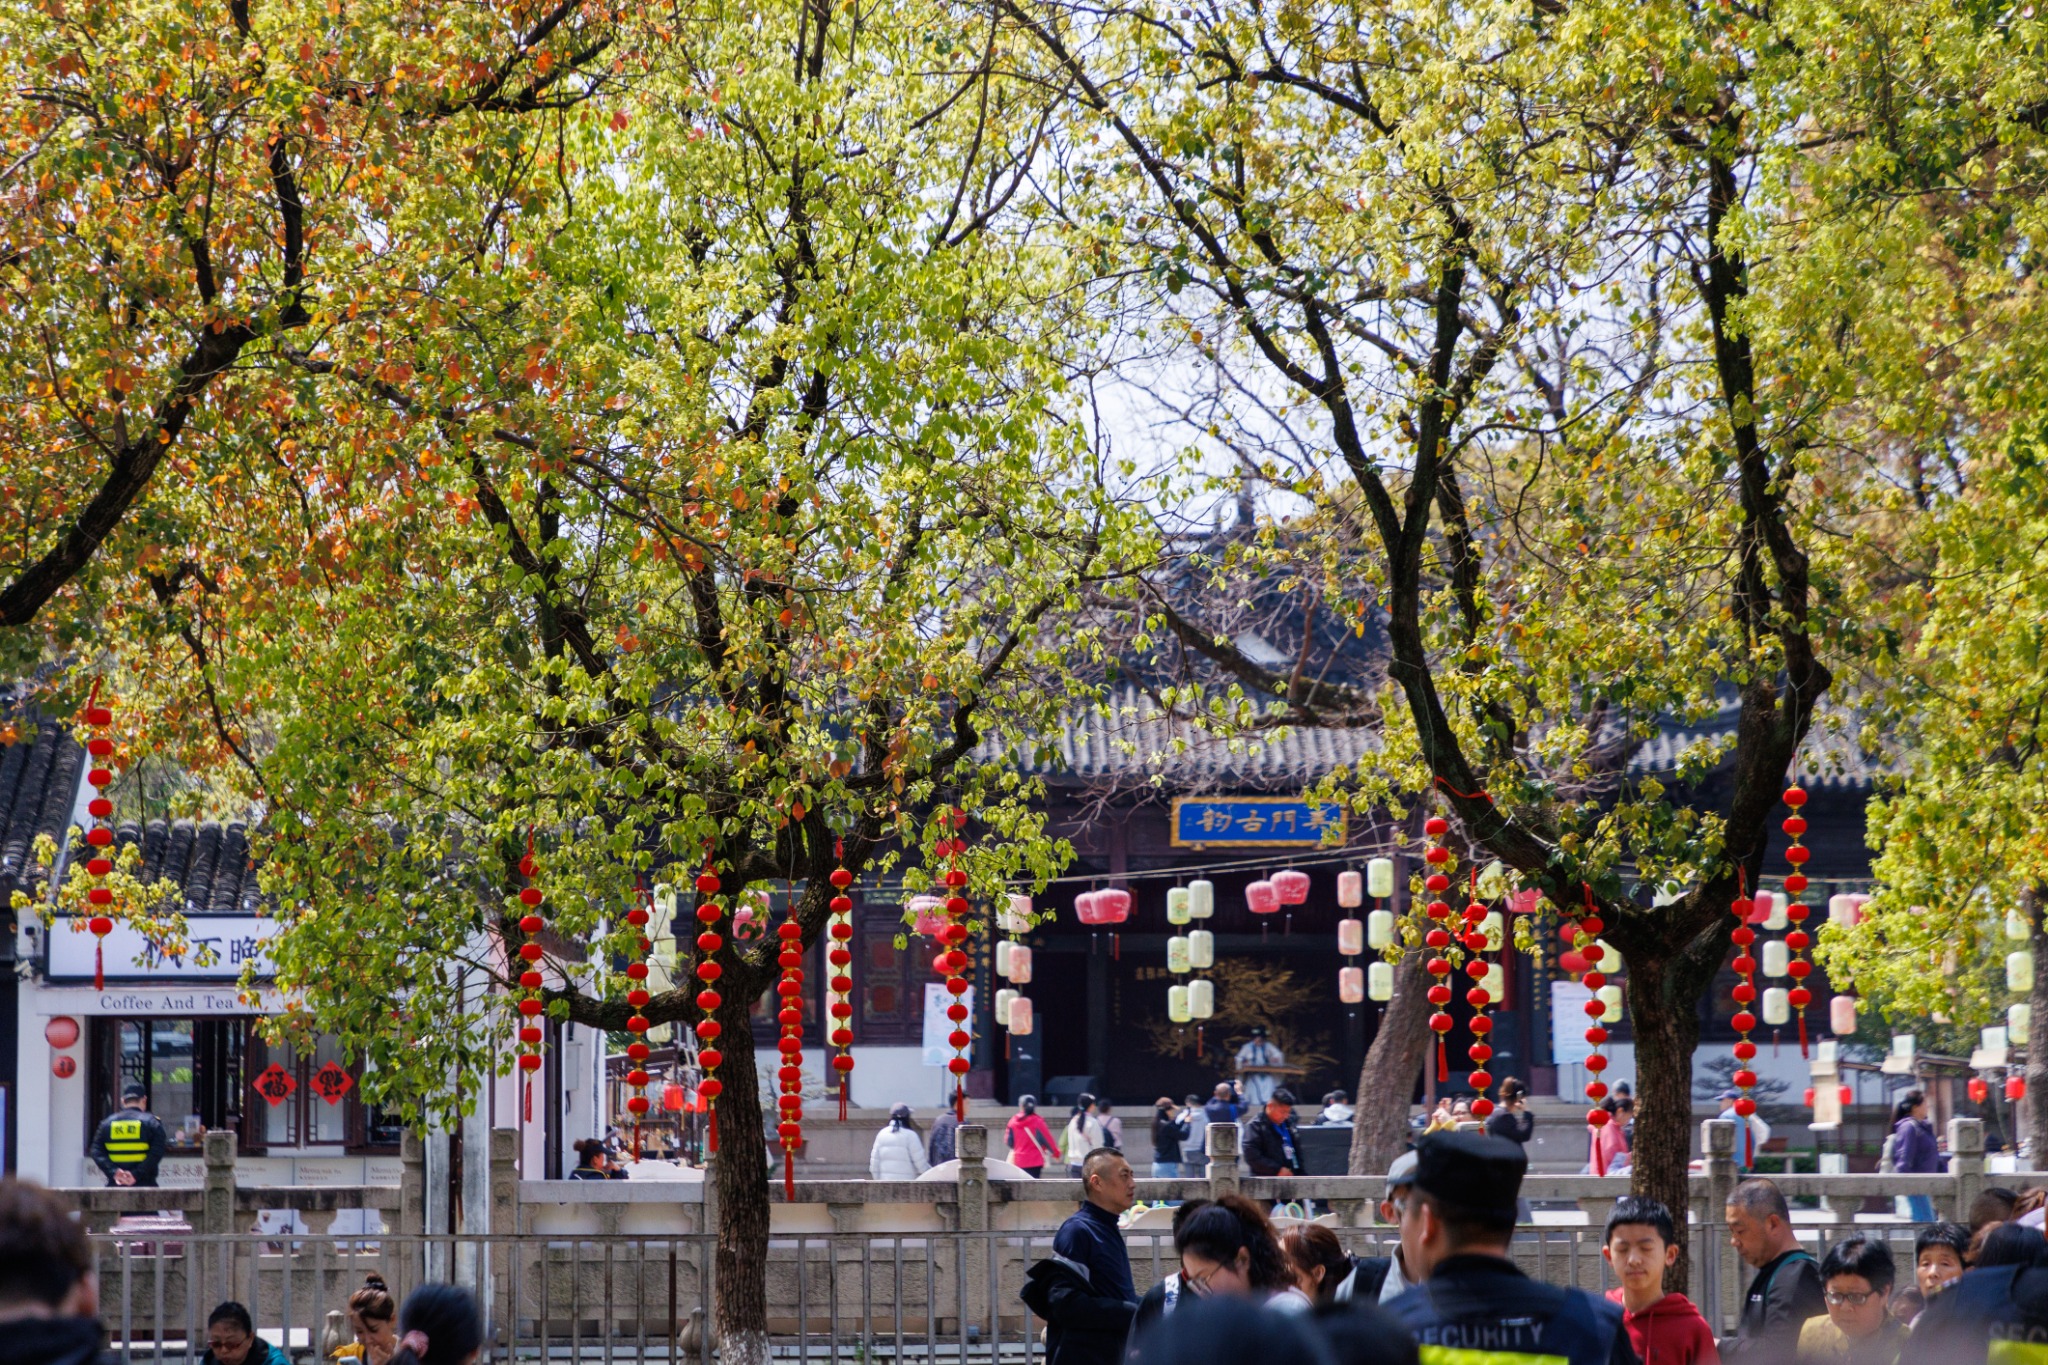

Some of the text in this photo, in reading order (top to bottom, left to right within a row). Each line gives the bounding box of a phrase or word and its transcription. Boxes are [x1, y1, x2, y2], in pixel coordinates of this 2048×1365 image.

[100, 995, 234, 1010] Coffee And Tea
